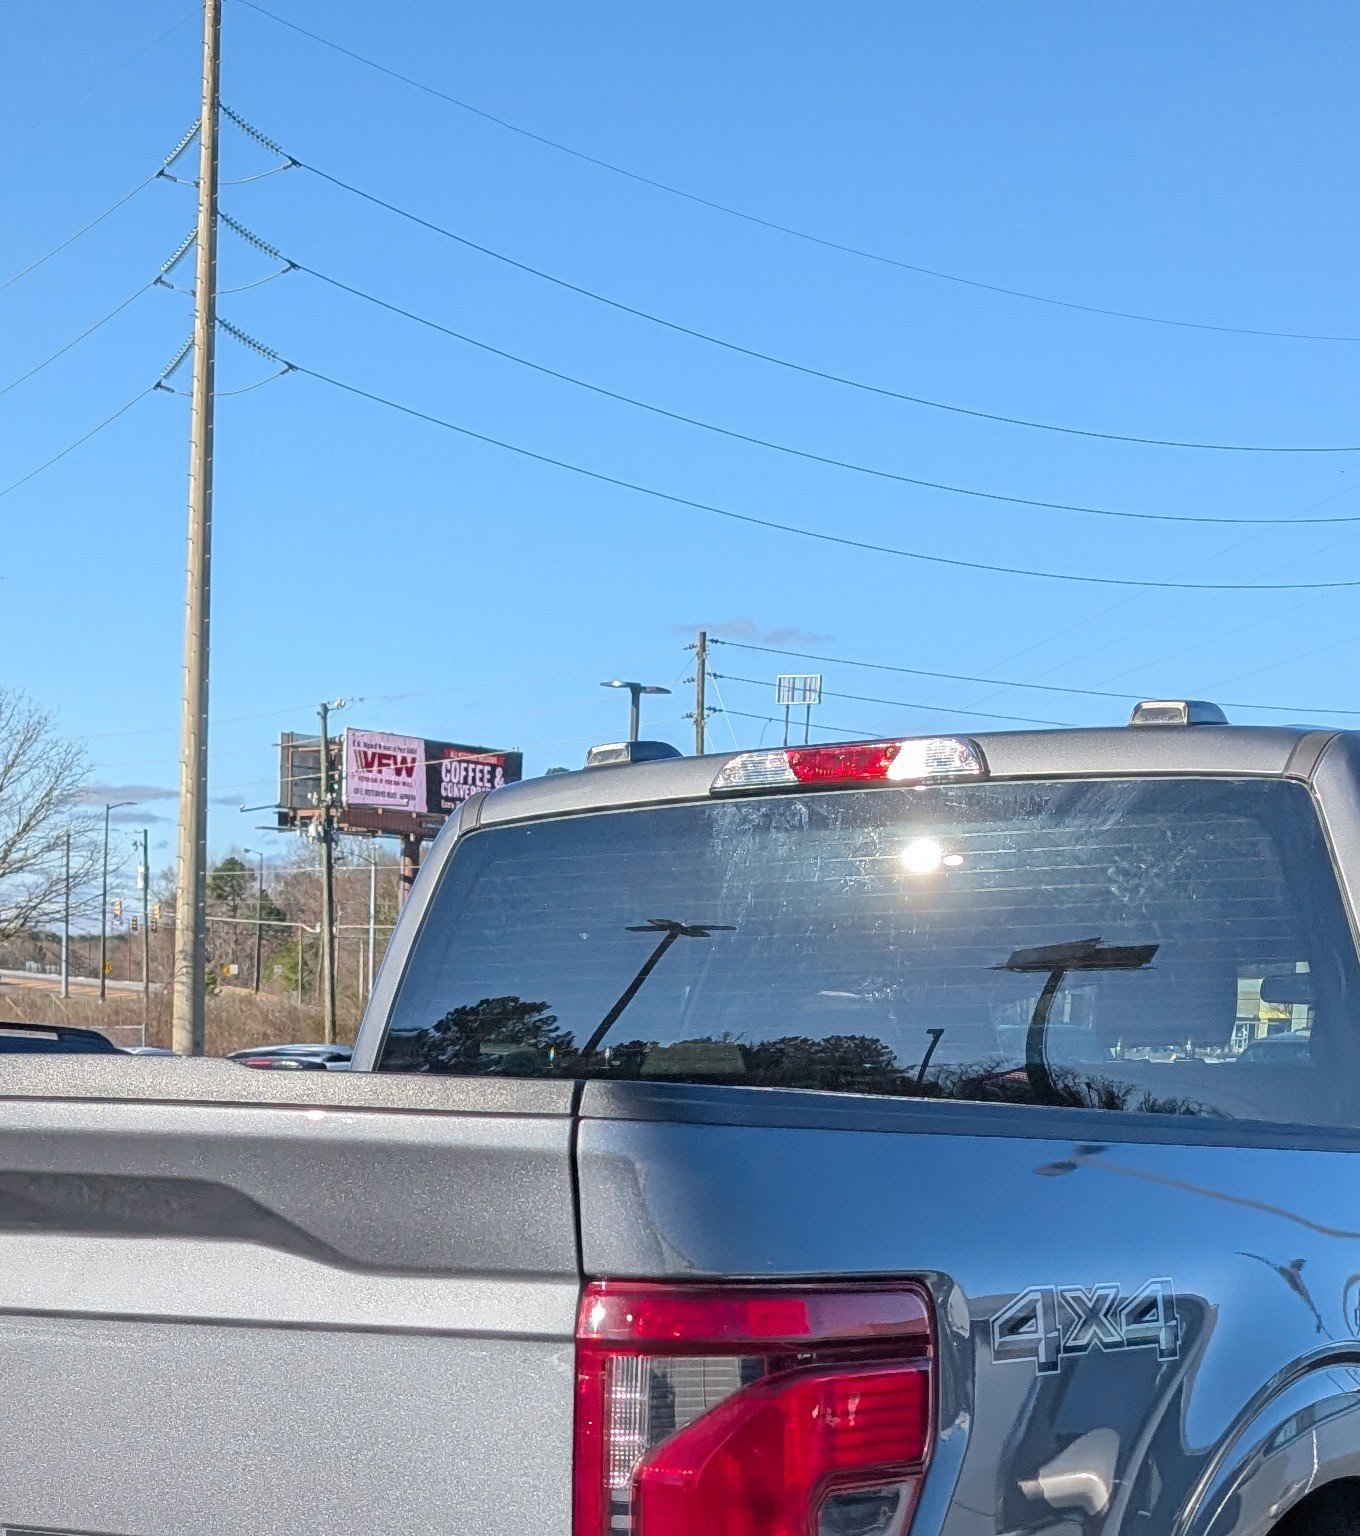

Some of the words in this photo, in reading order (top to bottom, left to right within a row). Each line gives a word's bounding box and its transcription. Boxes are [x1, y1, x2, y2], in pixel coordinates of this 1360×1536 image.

[355, 750, 417, 778] VFW
[441, 761, 491, 787] COFFEE
[494, 767, 505, 788] &
